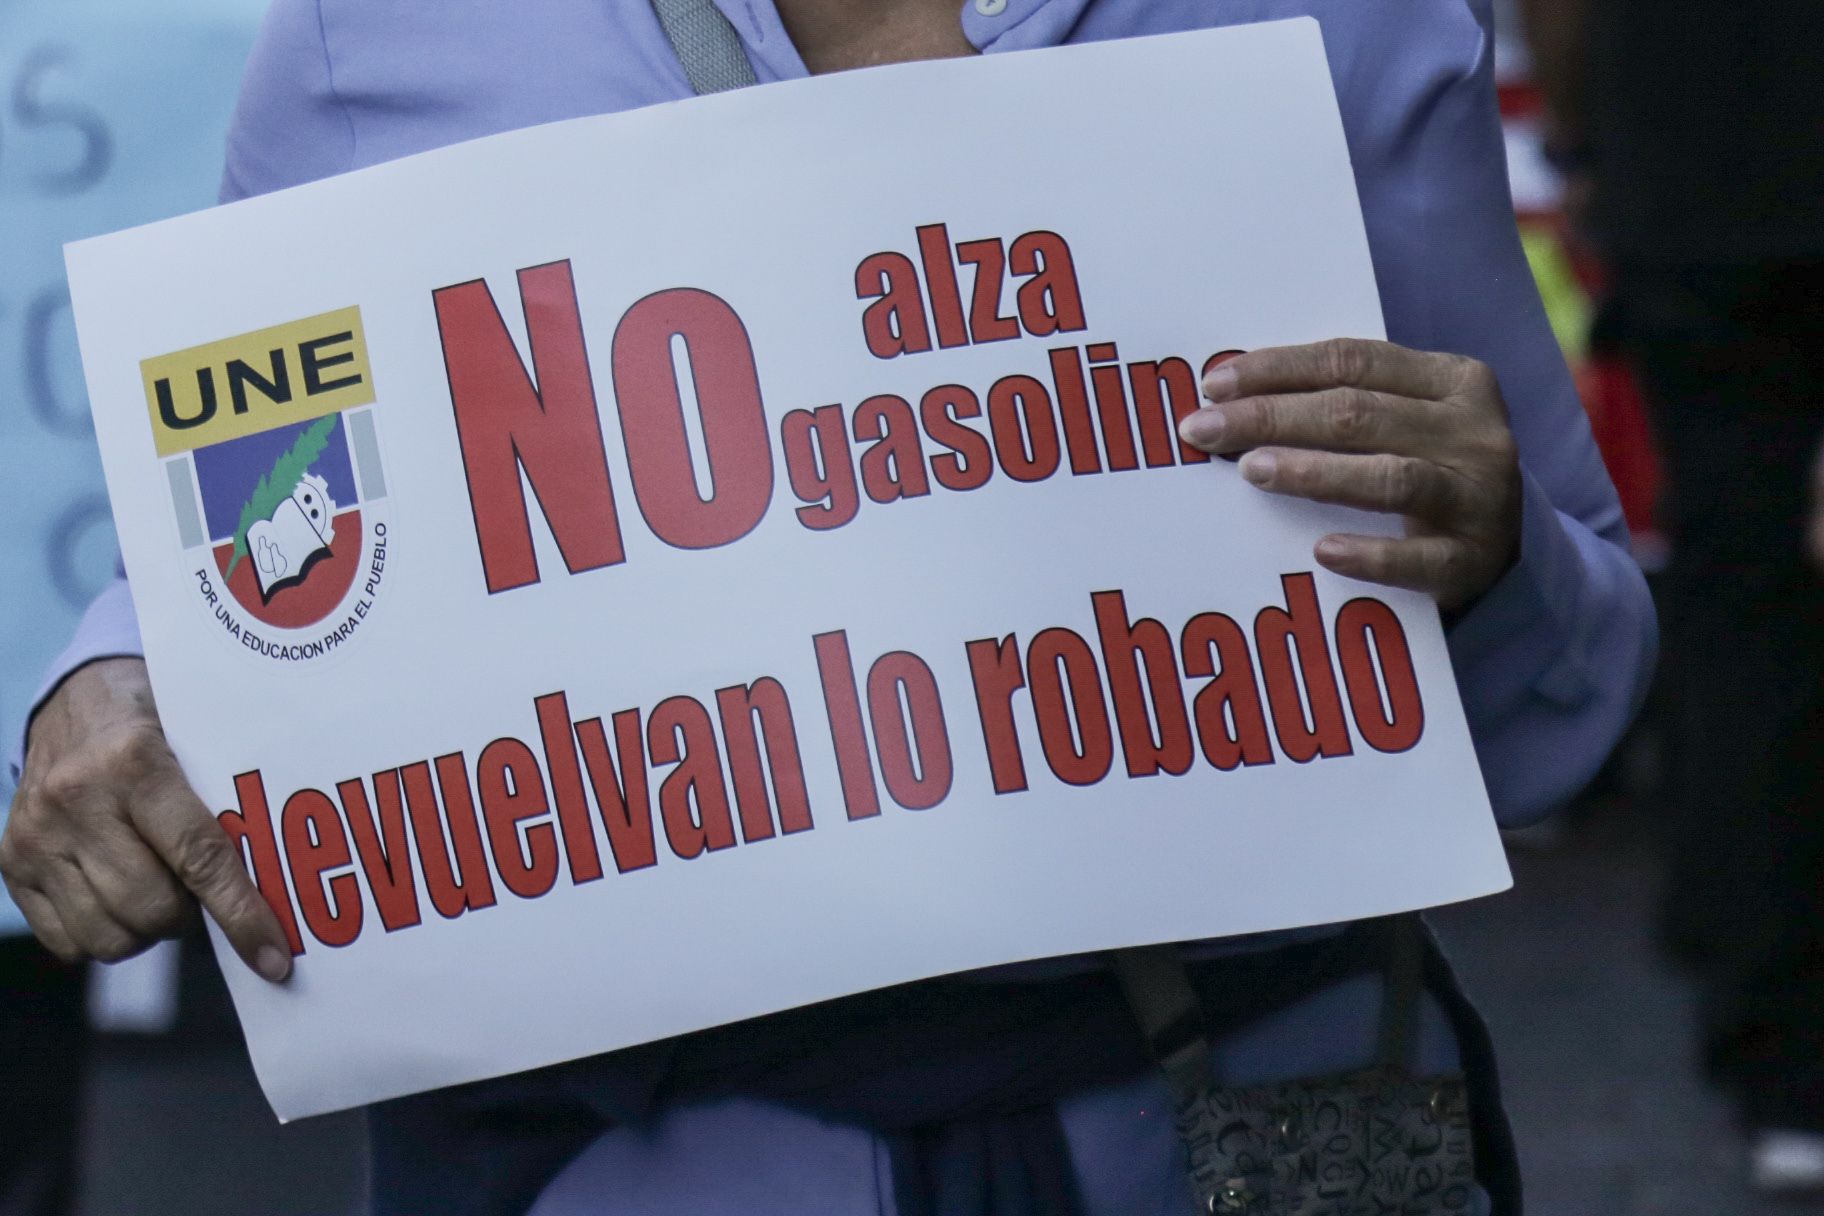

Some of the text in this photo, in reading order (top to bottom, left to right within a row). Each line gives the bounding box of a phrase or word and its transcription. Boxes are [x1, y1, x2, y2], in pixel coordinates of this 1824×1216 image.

[854, 222, 1087, 360] alza
[154, 330, 363, 430] UNE
[780, 341, 1250, 531] gasolin
[195, 522, 388, 661] POR UNA EDUCACION PARA EL PUEBLO
[216, 571, 1425, 956] devuelvan lo robado
